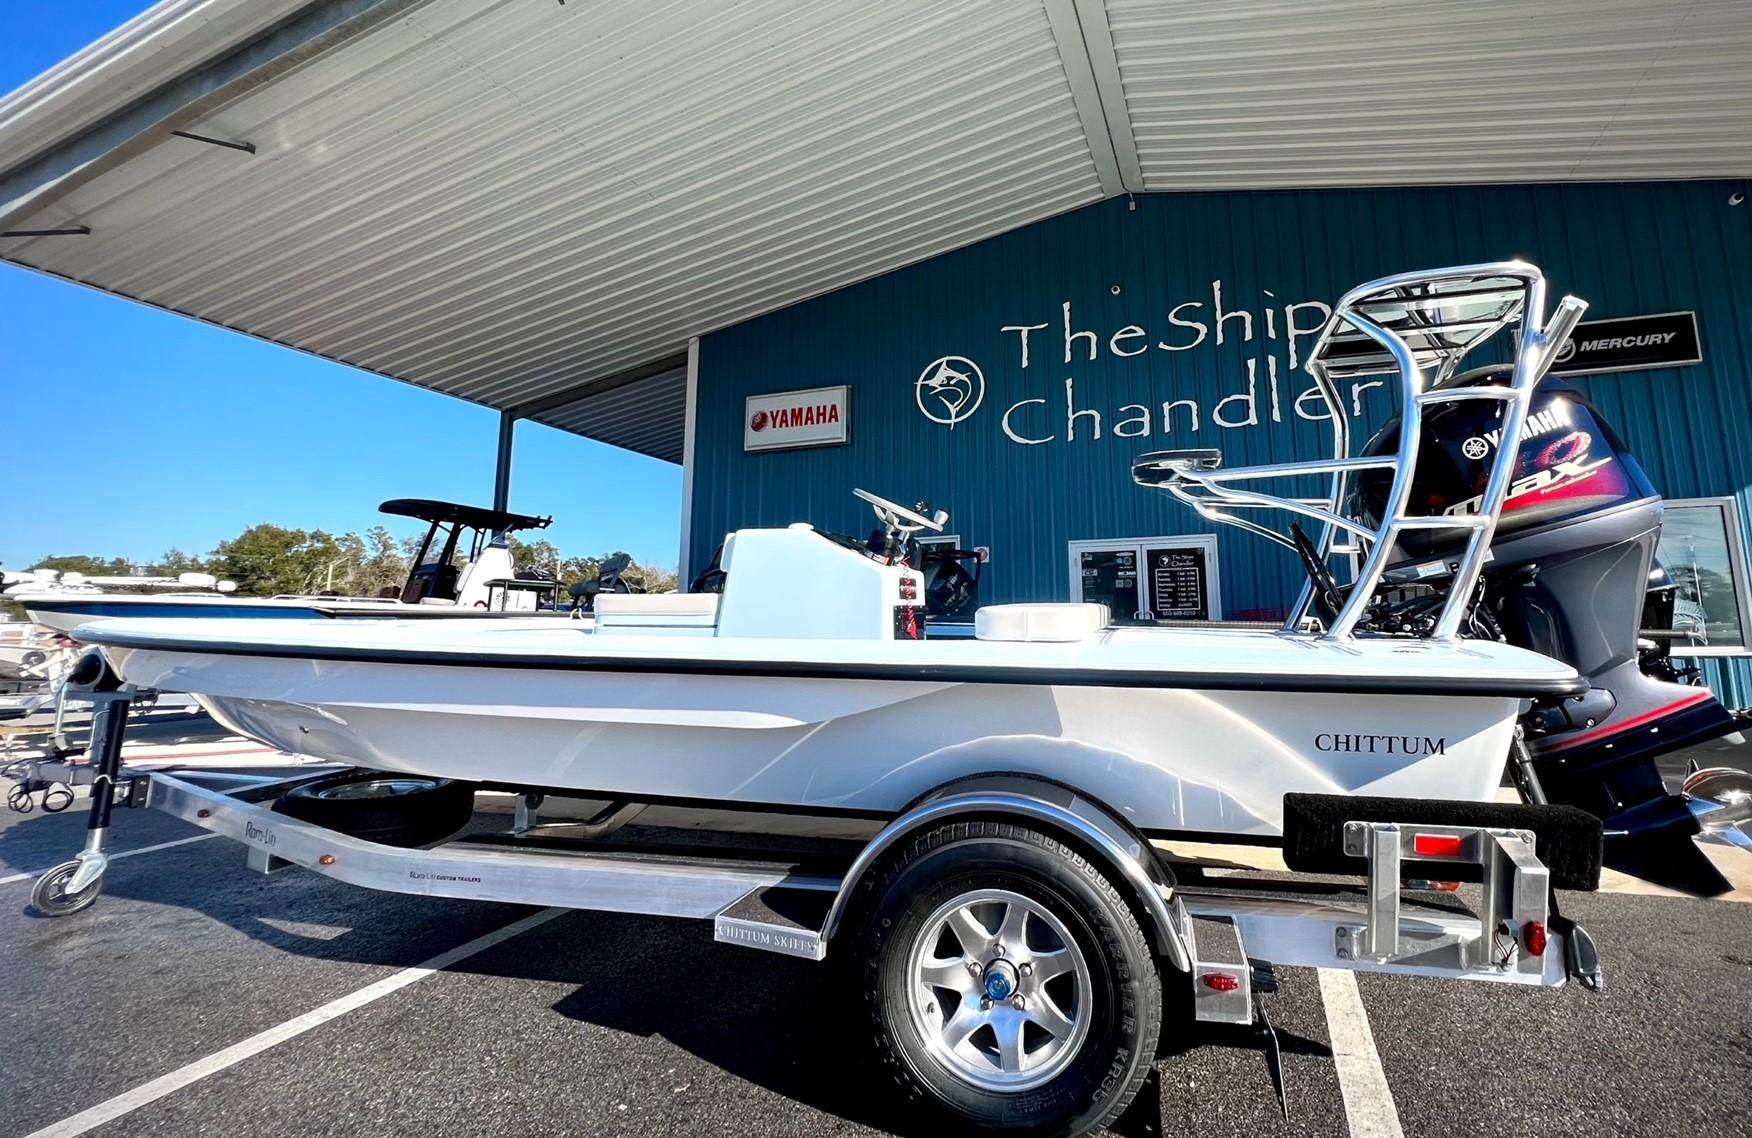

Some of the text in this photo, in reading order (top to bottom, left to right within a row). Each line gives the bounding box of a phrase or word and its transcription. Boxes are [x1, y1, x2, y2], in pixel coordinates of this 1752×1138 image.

[1001, 301, 1148, 369] The
[1580, 332, 1677, 352] MERCURY
[1001, 354, 1384, 444] Chandler
[770, 404, 839, 429] YAMAHA
[1315, 733, 1446, 756] CHITTUM
[718, 925, 817, 953] CHITTUM SKIFFS
